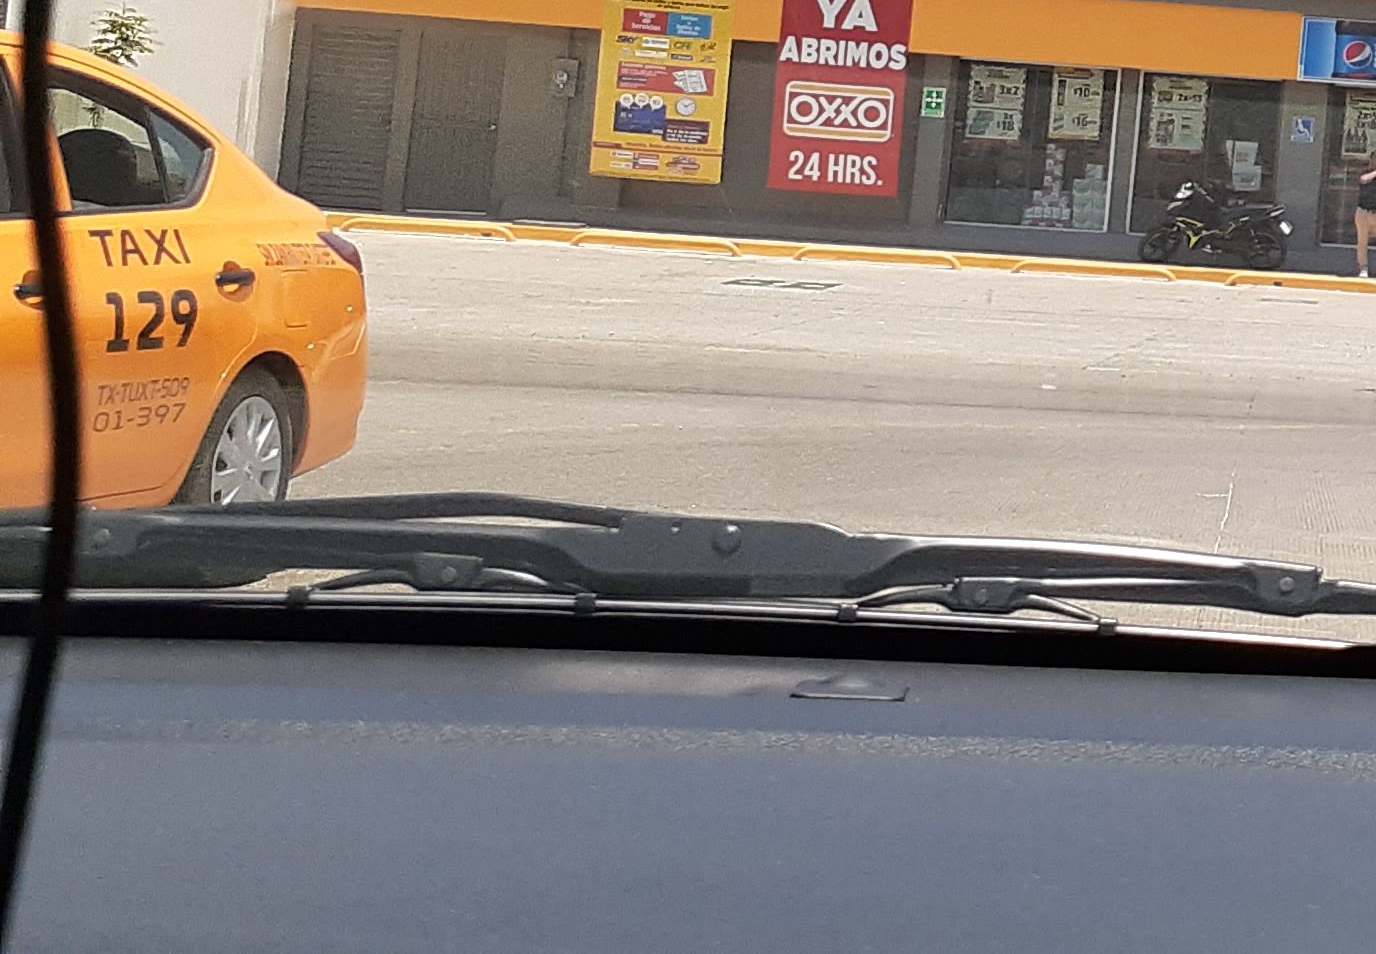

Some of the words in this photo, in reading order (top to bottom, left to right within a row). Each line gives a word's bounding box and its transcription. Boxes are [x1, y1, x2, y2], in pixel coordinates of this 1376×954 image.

[779, 35, 908, 70] ABRIMOS
[790, 94, 887, 128] OXXO
[788, 150, 821, 182] 24
[827, 153, 884, 187] HRS.
[88, 229, 192, 267] TAXI
[105, 289, 199, 353] 129
